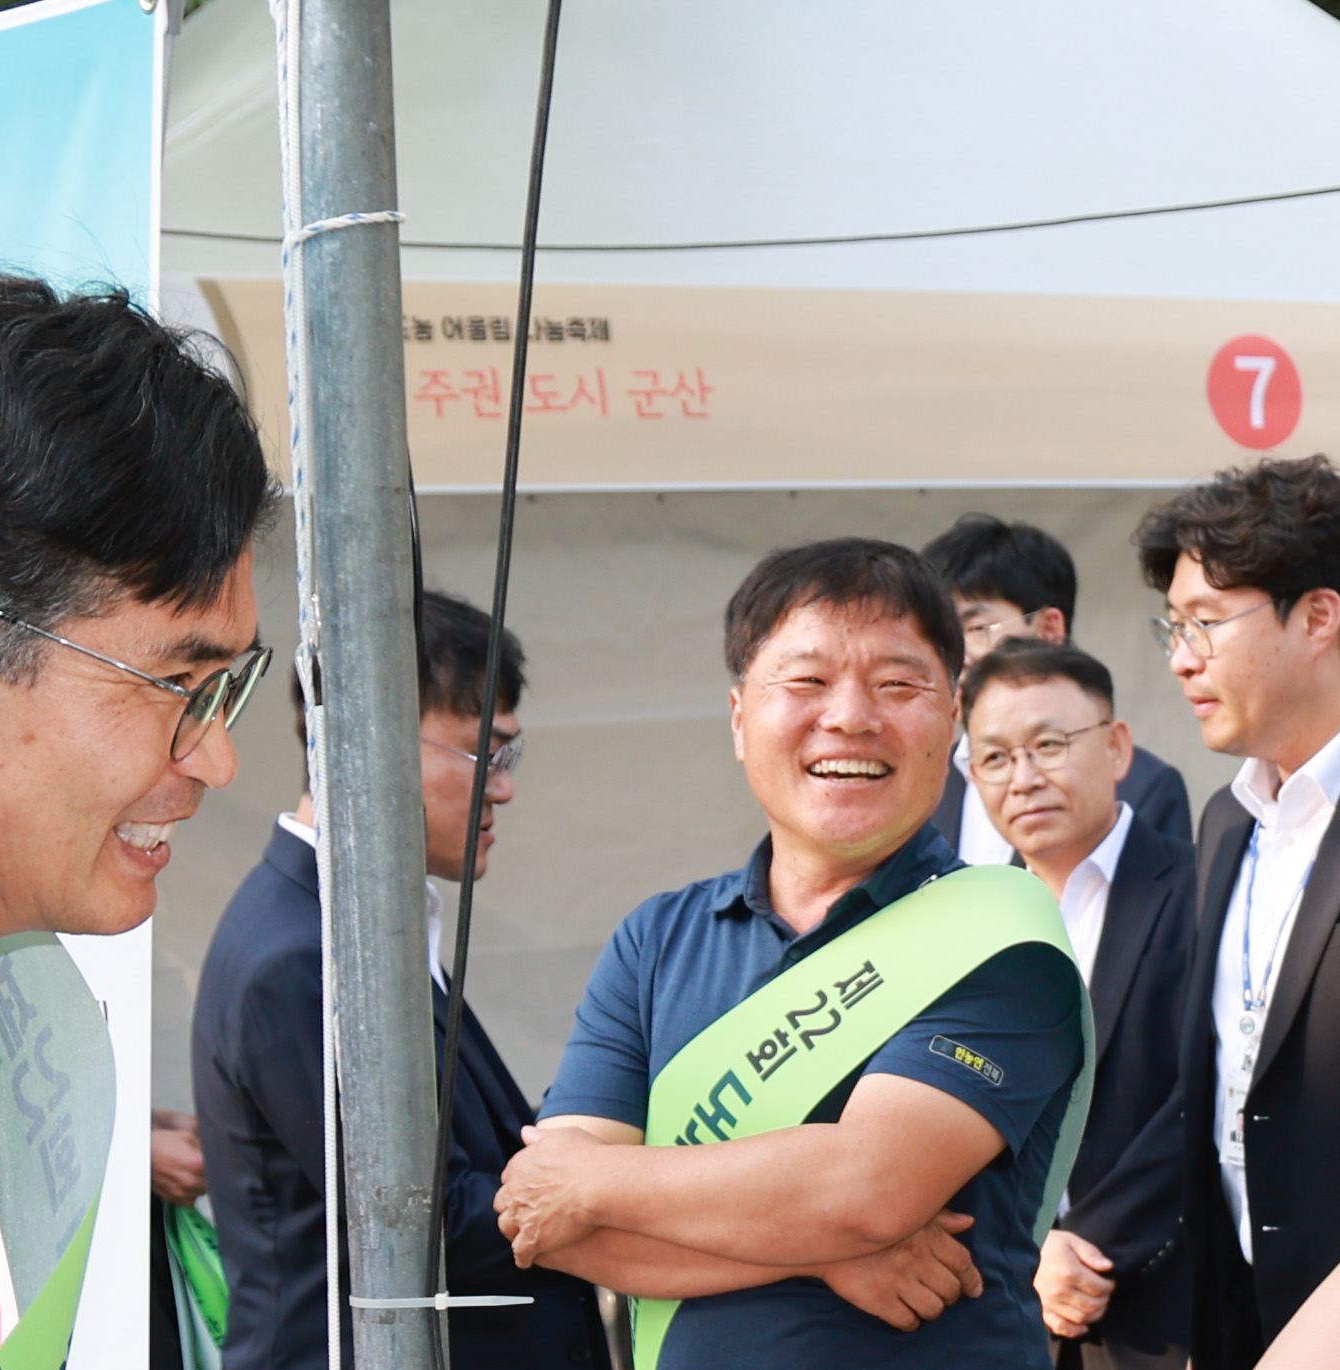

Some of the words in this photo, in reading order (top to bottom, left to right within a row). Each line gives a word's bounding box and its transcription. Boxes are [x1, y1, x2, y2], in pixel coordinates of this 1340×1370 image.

[525, 366, 610, 418] 도시
[627, 366, 714, 420] 군산
[1232, 356, 1276, 430] 7
[746, 960, 884, 1081] 제22회
